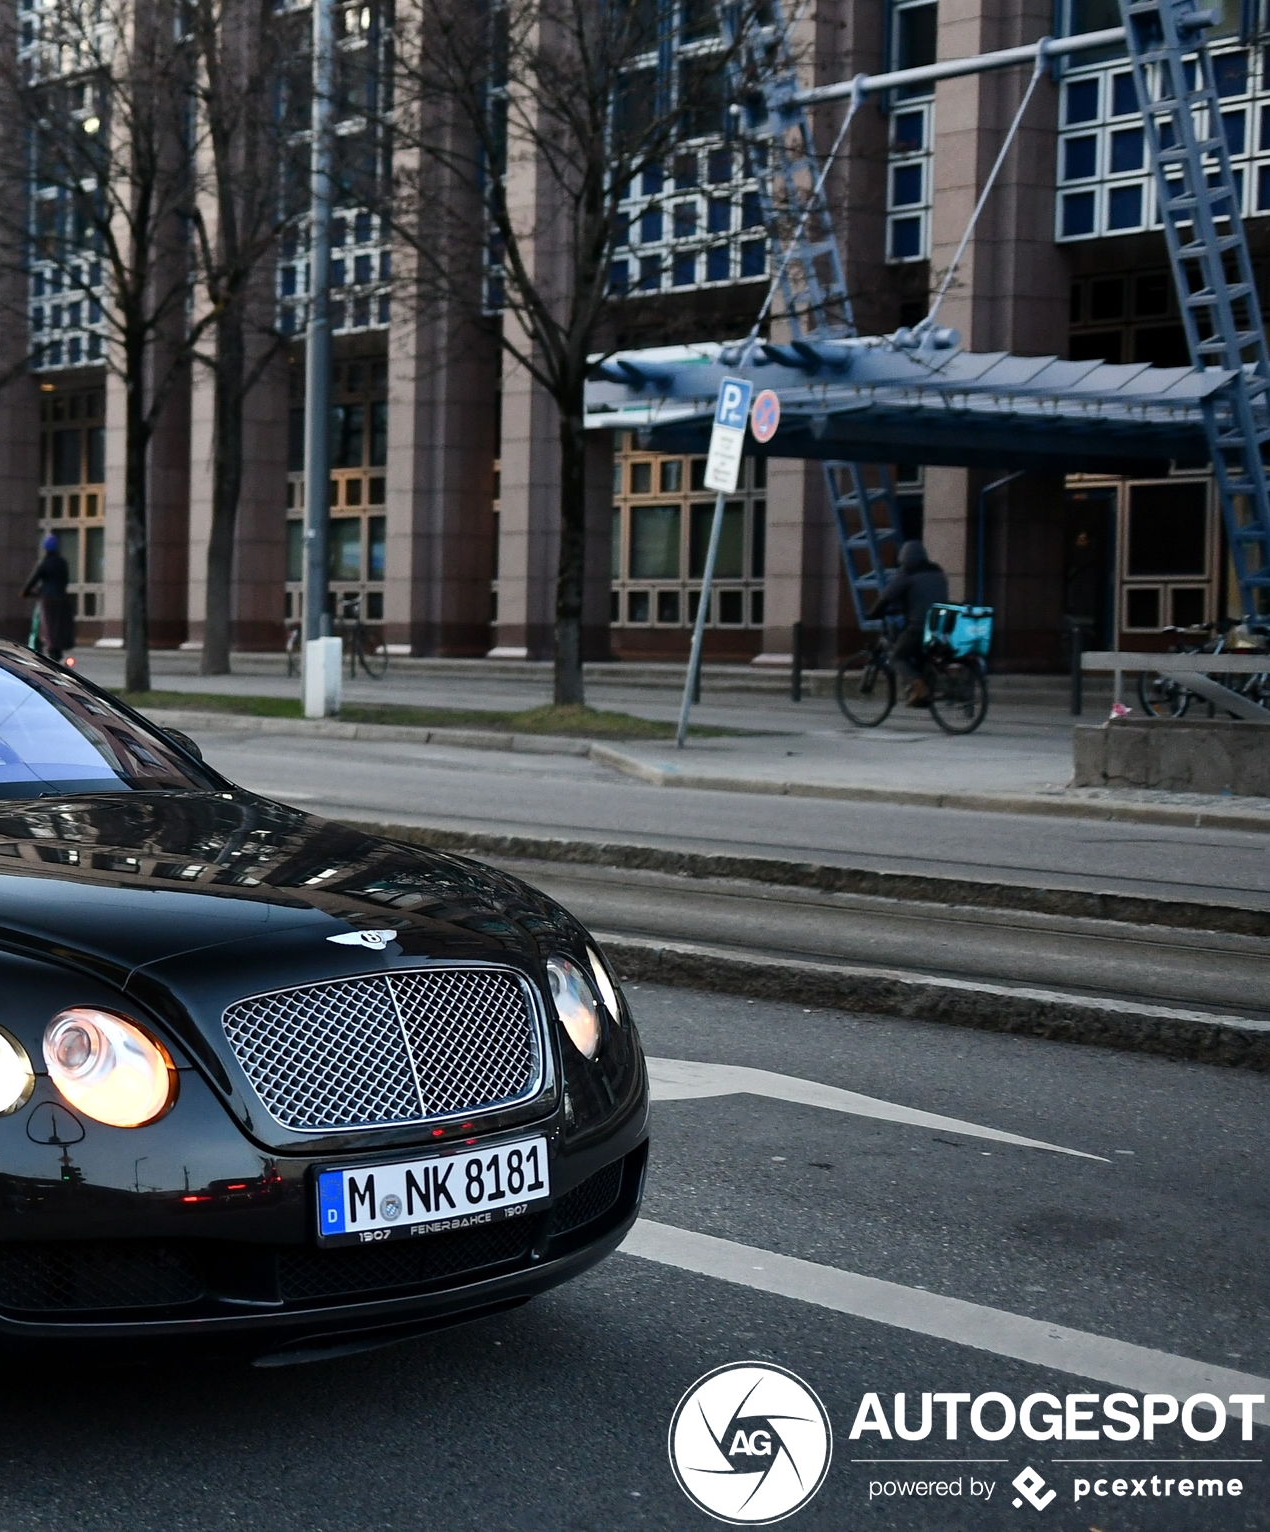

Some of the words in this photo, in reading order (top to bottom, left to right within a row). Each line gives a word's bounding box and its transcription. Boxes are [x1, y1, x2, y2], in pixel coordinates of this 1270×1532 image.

[720, 384, 742, 421] P
[348, 1173, 376, 1223] M
[405, 1162, 457, 1216] NK
[465, 1145, 544, 1205] 8181
[327, 1208, 338, 1223] D
[358, 1229, 392, 1243] 1907
[410, 1212, 492, 1236] FENERBAHCE
[503, 1204, 528, 1218] 1907
